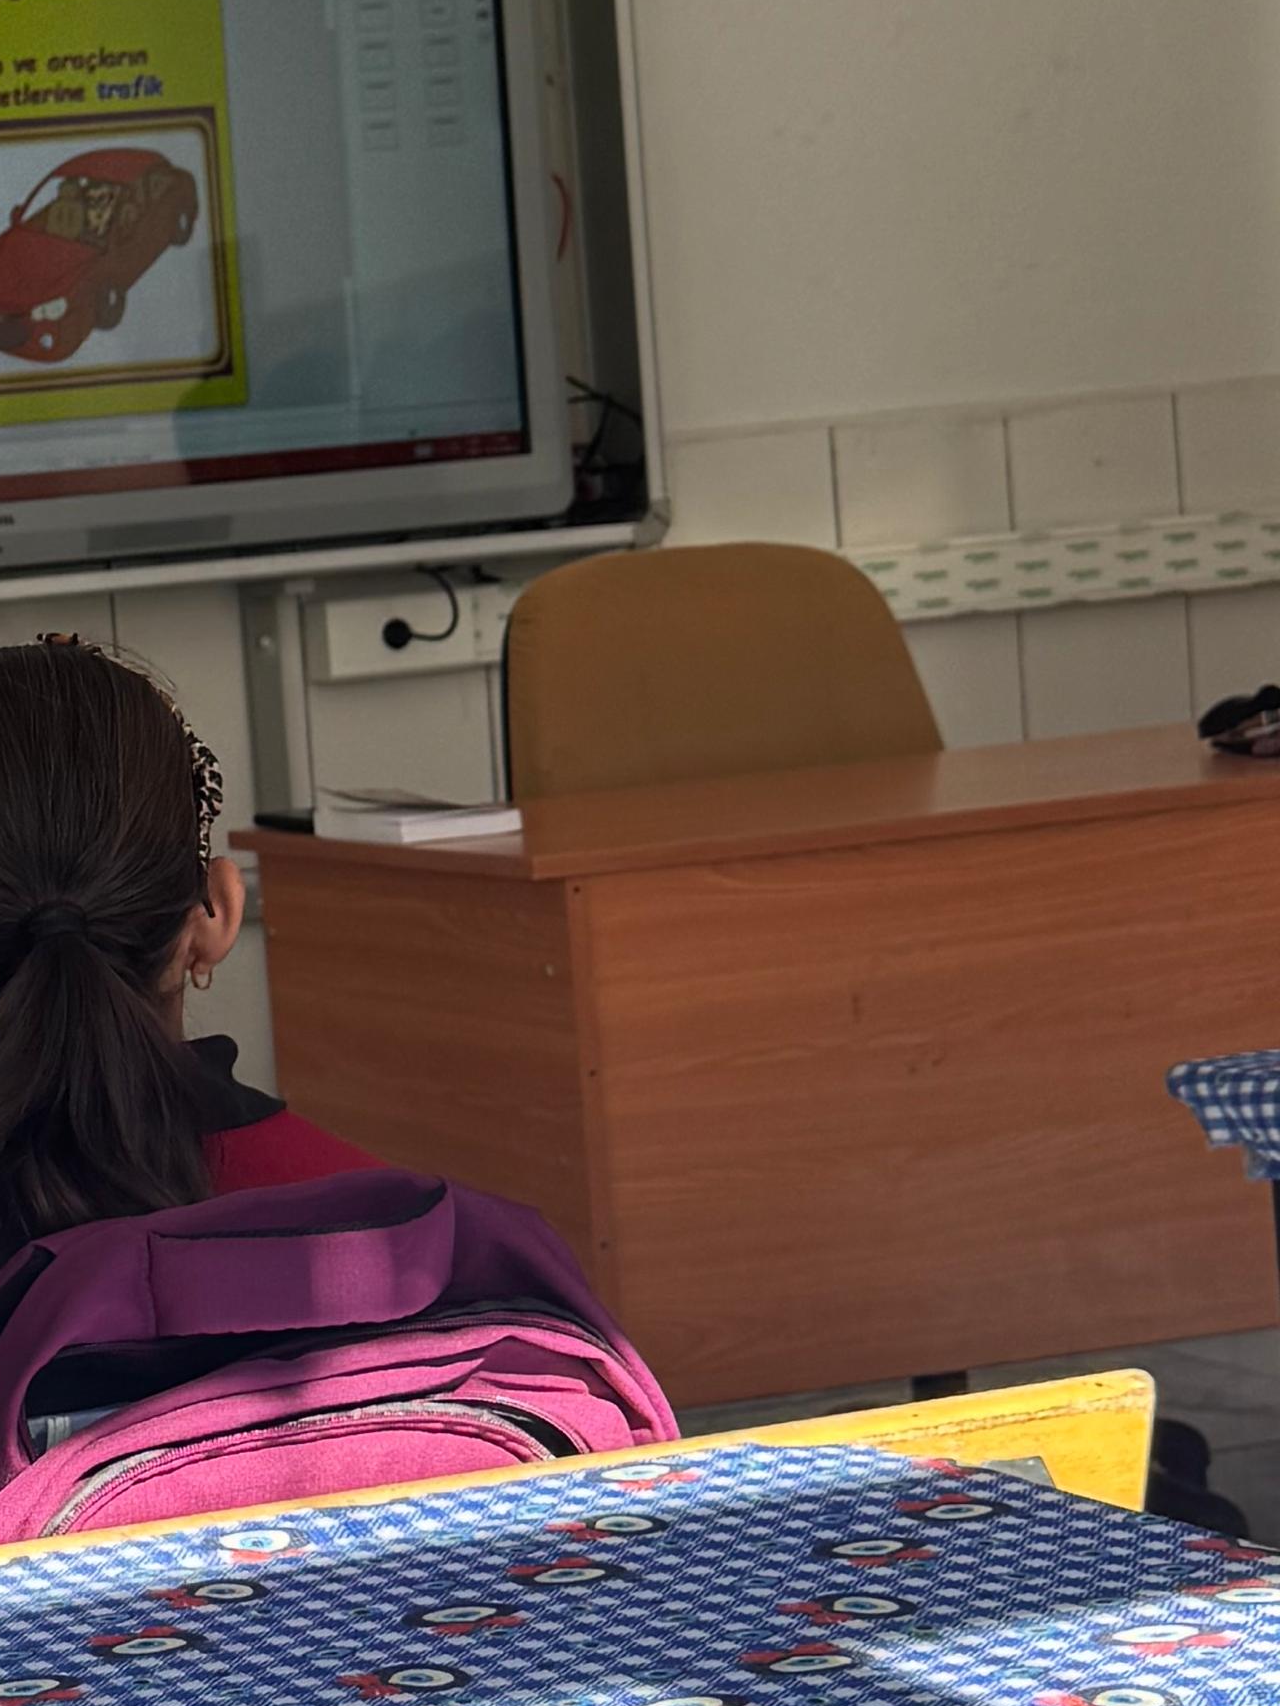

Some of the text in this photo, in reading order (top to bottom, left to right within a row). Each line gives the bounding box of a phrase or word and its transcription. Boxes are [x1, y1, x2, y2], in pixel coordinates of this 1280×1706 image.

[13, 57, 37, 73] ve
[48, 48, 148, 73] araçların
[97, 75, 164, 99] trafik
